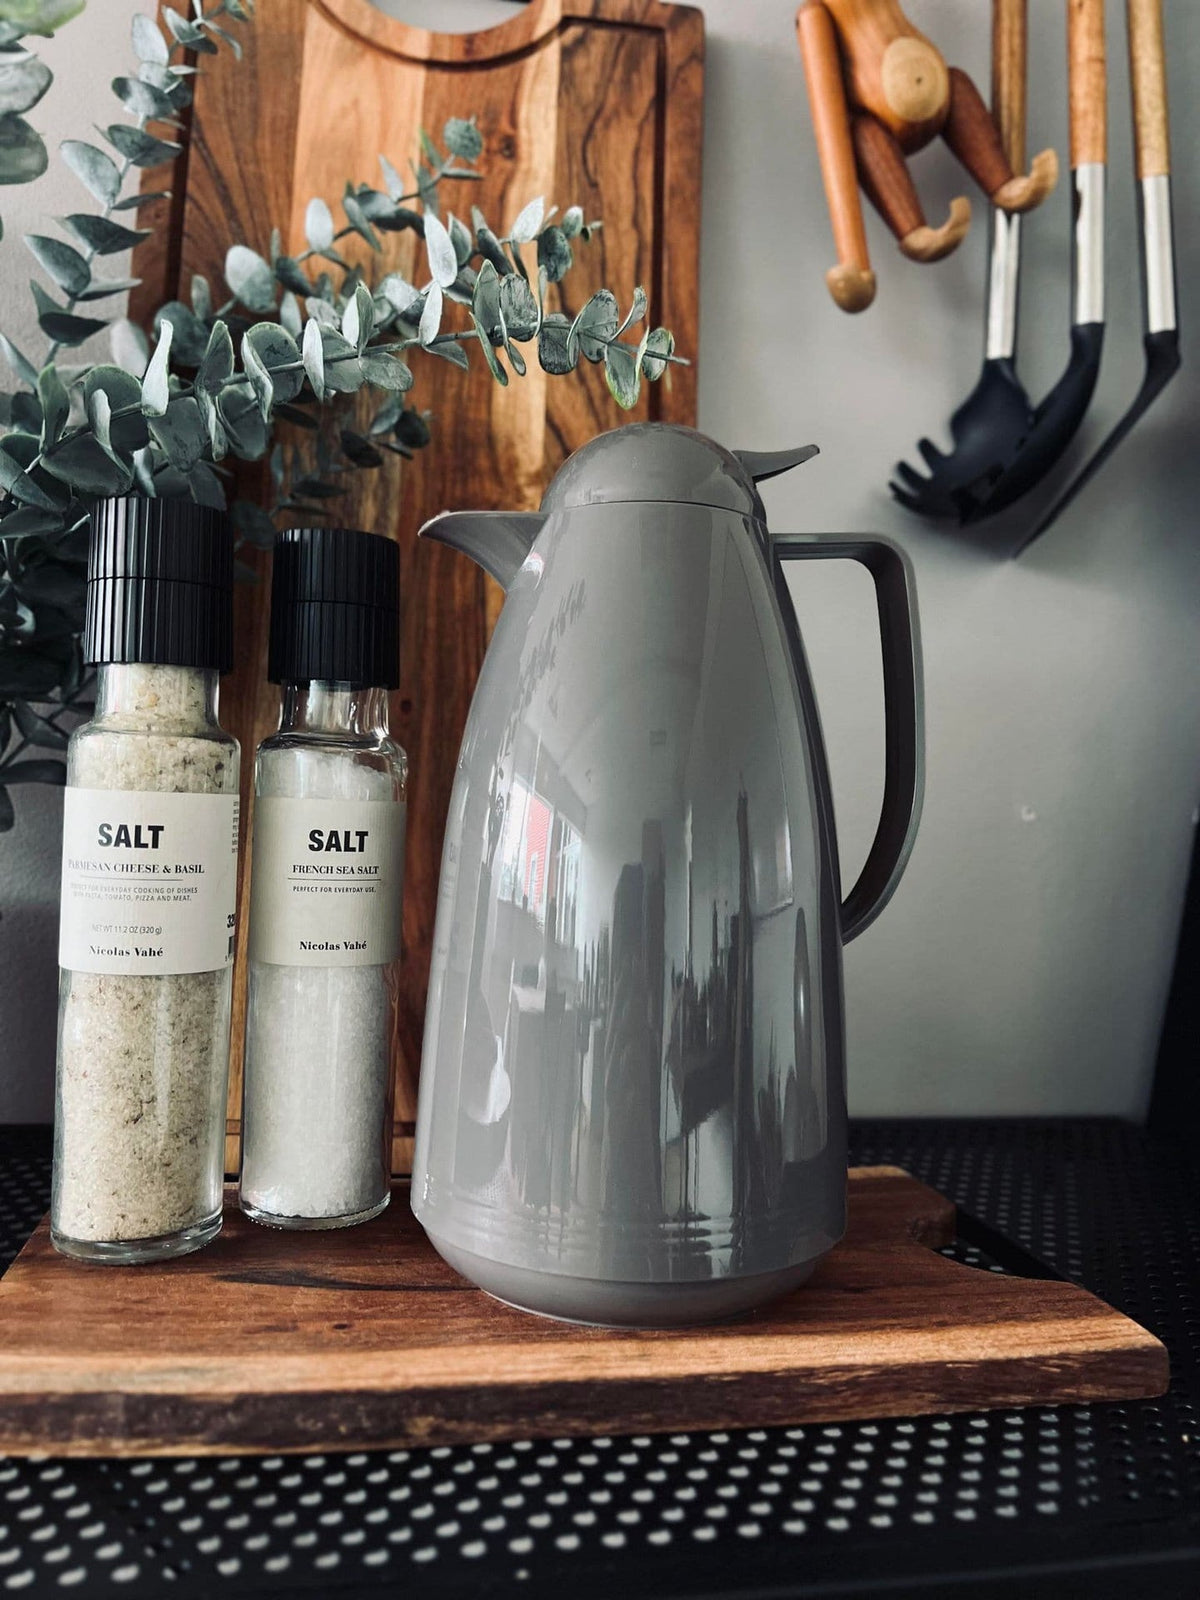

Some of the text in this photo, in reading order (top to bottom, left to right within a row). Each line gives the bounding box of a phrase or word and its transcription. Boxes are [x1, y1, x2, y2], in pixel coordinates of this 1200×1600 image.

[97, 823, 165, 849] SALT
[308, 829, 369, 852] SALT
[113, 863, 160, 873] CHEESE
[162, 864, 172, 873] &
[174, 864, 205, 874] BASIL
[292, 864, 379, 875] FRENCH SEA SALT
[114, 925, 127, 934] 112
[139, 925, 155, 935] (320
[89, 945, 164, 957] Nicolas Vahé
[299, 940, 368, 951] Nicolas Vahé
